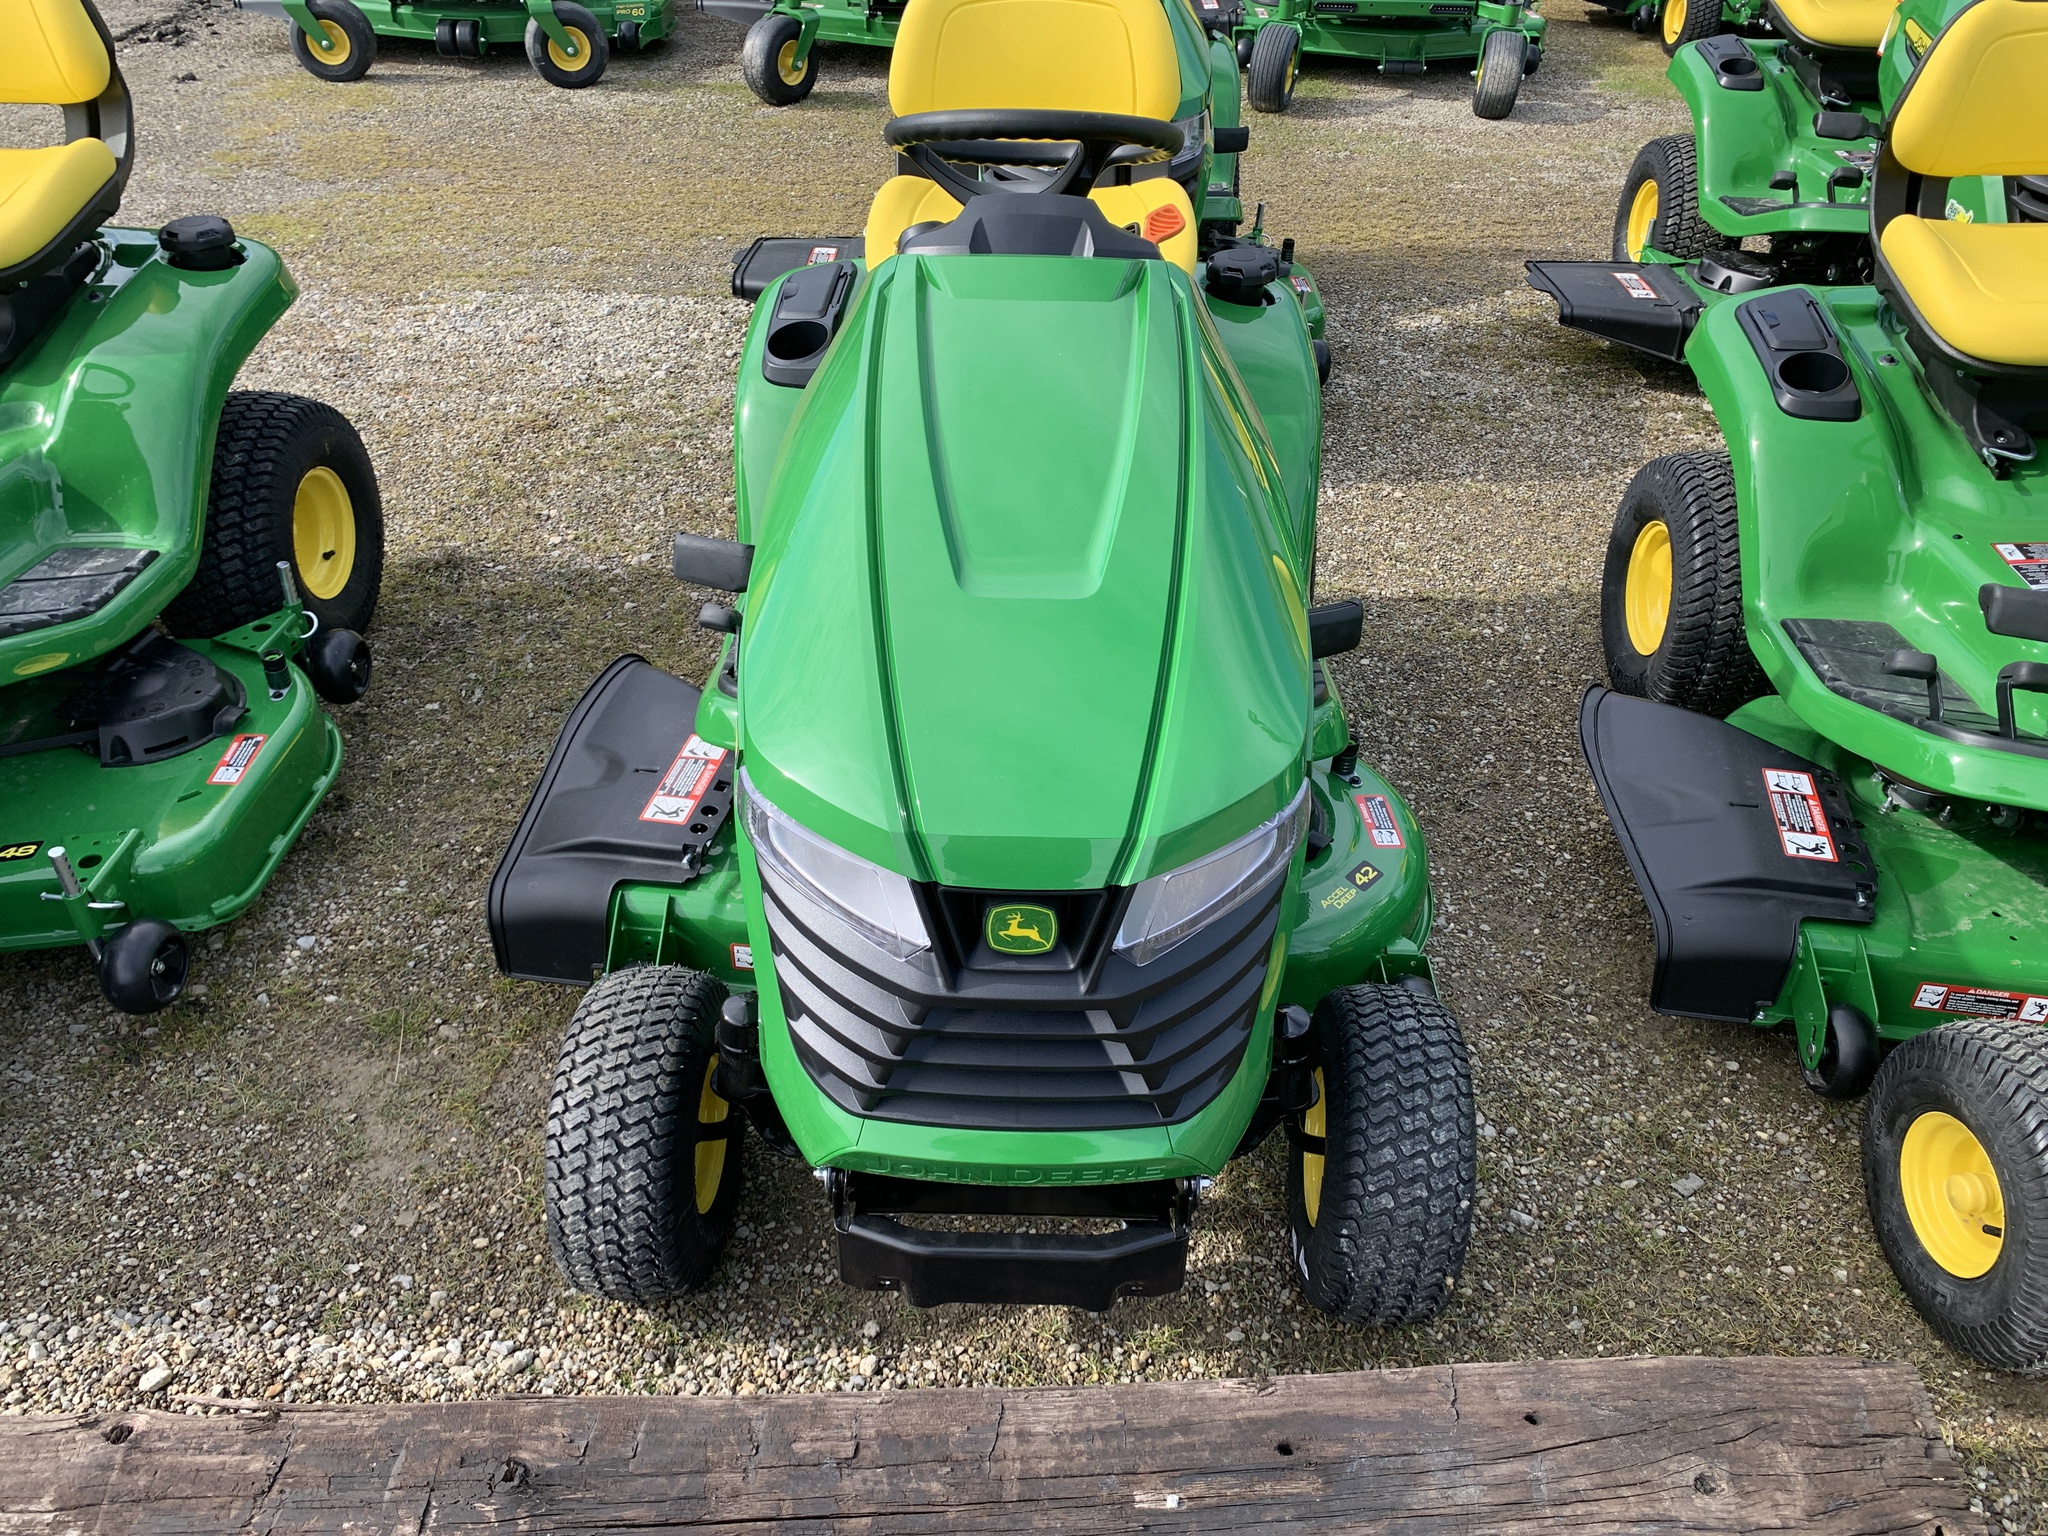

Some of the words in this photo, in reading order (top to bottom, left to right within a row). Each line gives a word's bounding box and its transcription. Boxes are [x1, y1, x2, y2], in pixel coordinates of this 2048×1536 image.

[631, 7, 645, 16] 60
[692, 770, 714, 796] DANGER
[1810, 805, 1827, 832] DANGER
[0, 845, 38, 859] 48
[1355, 866, 1378, 886] 42
[1320, 886, 1349, 909] ACCEL
[1333, 888, 1357, 909] DEEP
[1975, 988, 2010, 998] DANGER
[864, 1156, 992, 1183] JOHN
[1007, 1165, 1167, 1184] DEERE
